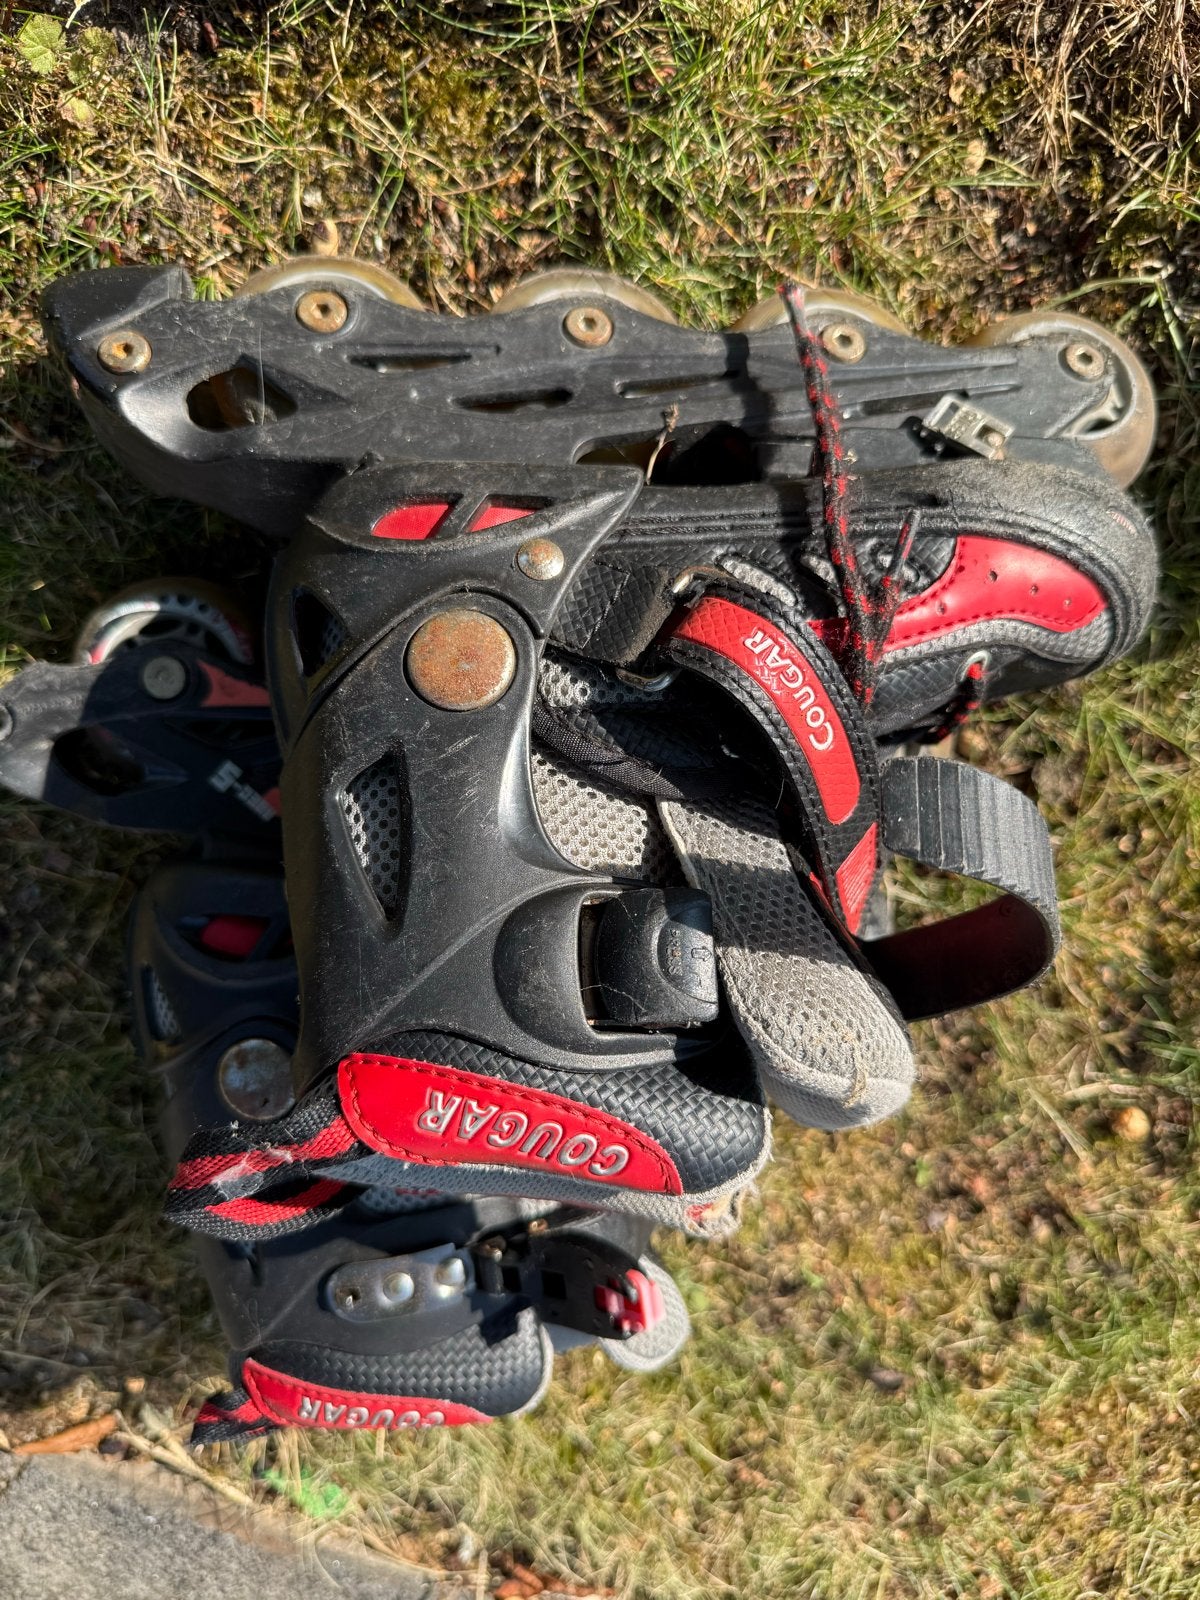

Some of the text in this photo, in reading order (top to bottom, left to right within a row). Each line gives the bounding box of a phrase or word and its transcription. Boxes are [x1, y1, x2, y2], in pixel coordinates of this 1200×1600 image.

[743, 629, 834, 751] COUGAR
[417, 1089, 630, 1176] COUGAR
[298, 1396, 445, 1428] COUGAR
